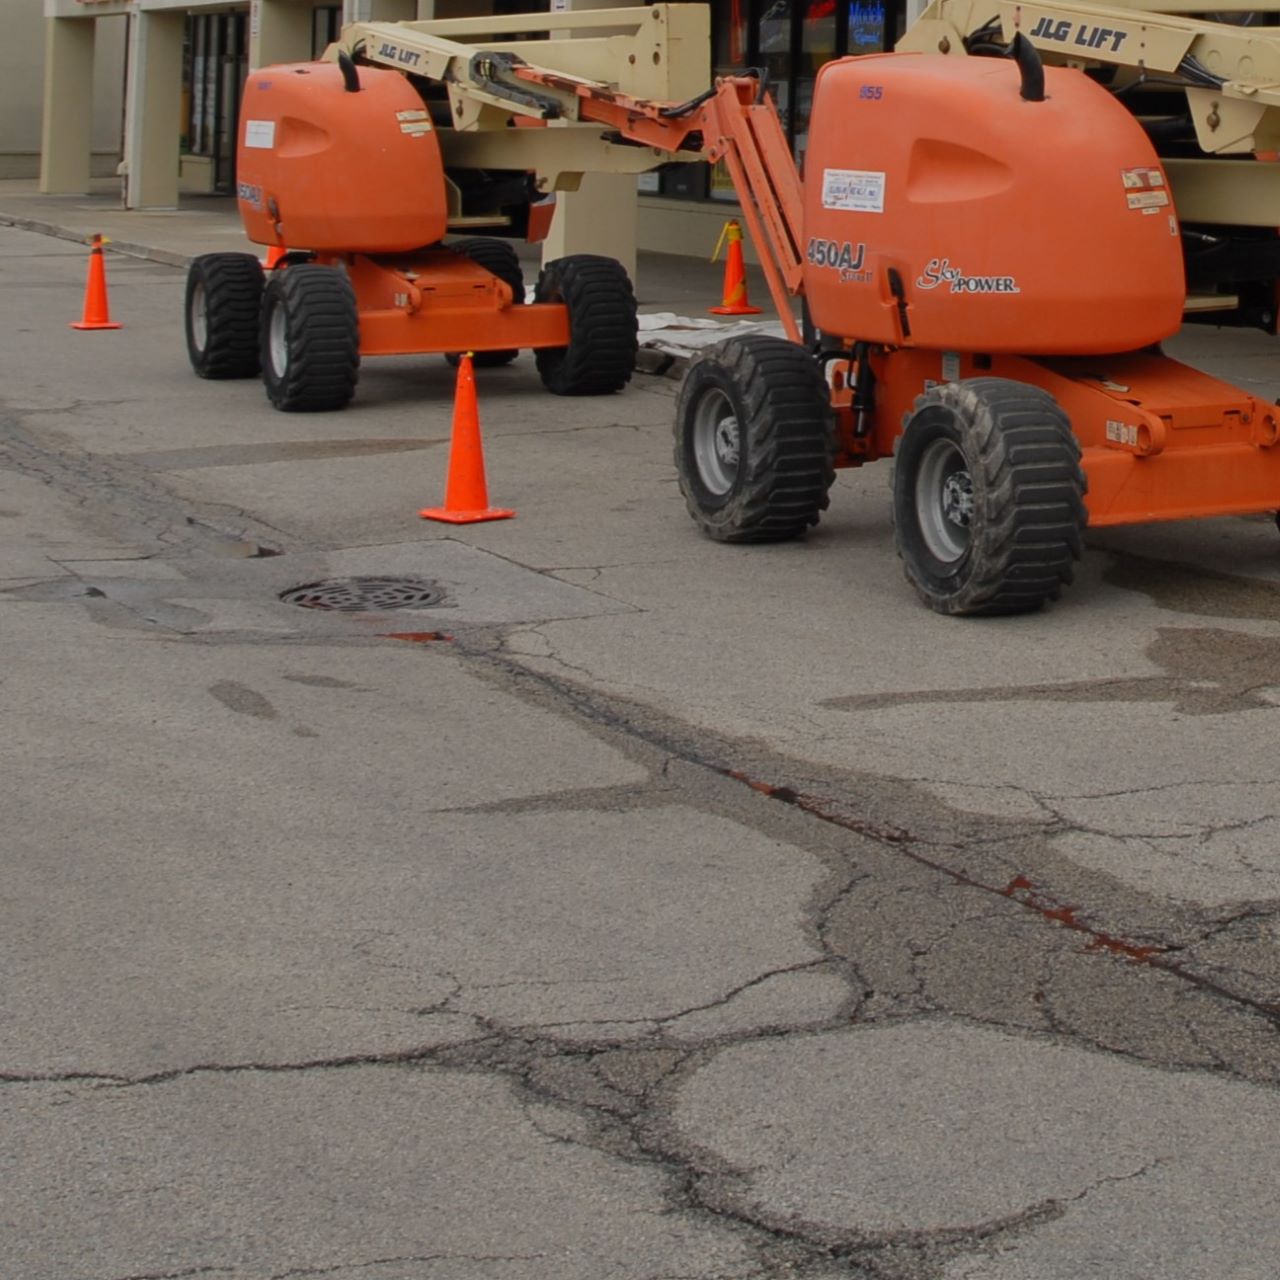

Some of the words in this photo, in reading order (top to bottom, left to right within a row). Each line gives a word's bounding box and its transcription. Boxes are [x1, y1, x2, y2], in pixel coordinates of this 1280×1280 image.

[1030, 17, 1072, 42] JLG
[1075, 25, 1127, 52] LIFT
[378, 43, 397, 59] JLG
[398, 49, 421, 66] LIFT
[808, 238, 865, 269] 450AJ
